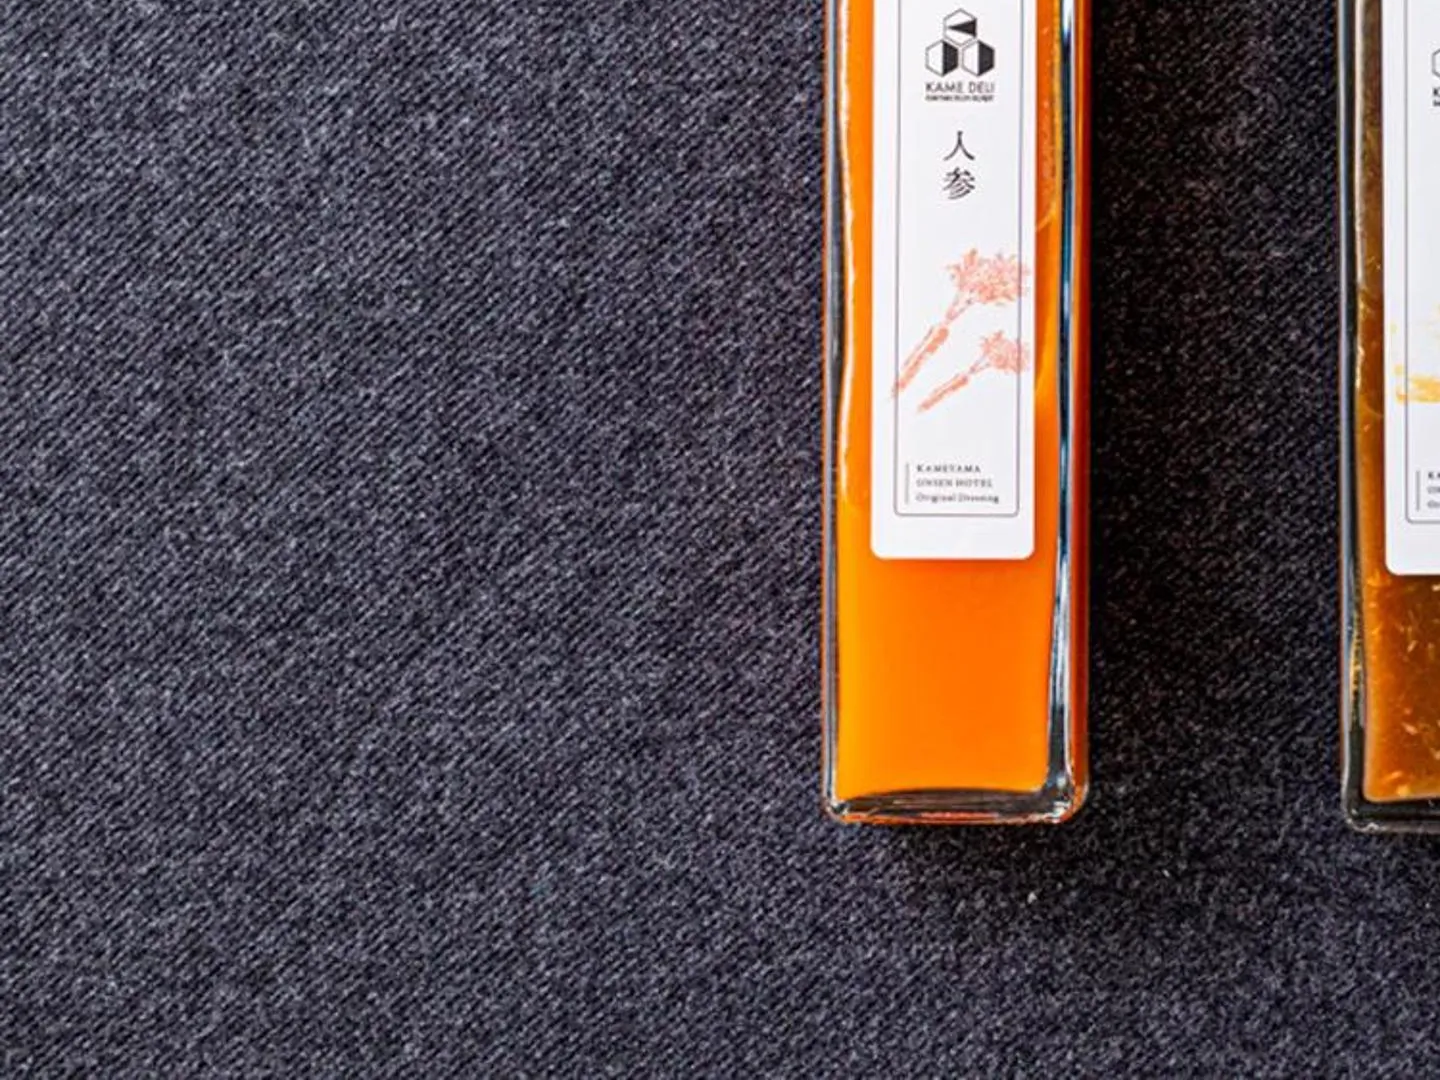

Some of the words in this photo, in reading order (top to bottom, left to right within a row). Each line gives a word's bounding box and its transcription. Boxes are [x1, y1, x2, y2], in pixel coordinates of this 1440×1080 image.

[926, 81, 963, 94] KAME
[968, 81, 996, 94] DELI
[943, 130, 976, 200] 人参
[917, 464, 981, 473] KAMEYAMA
[956, 479, 992, 487] HOTEL
